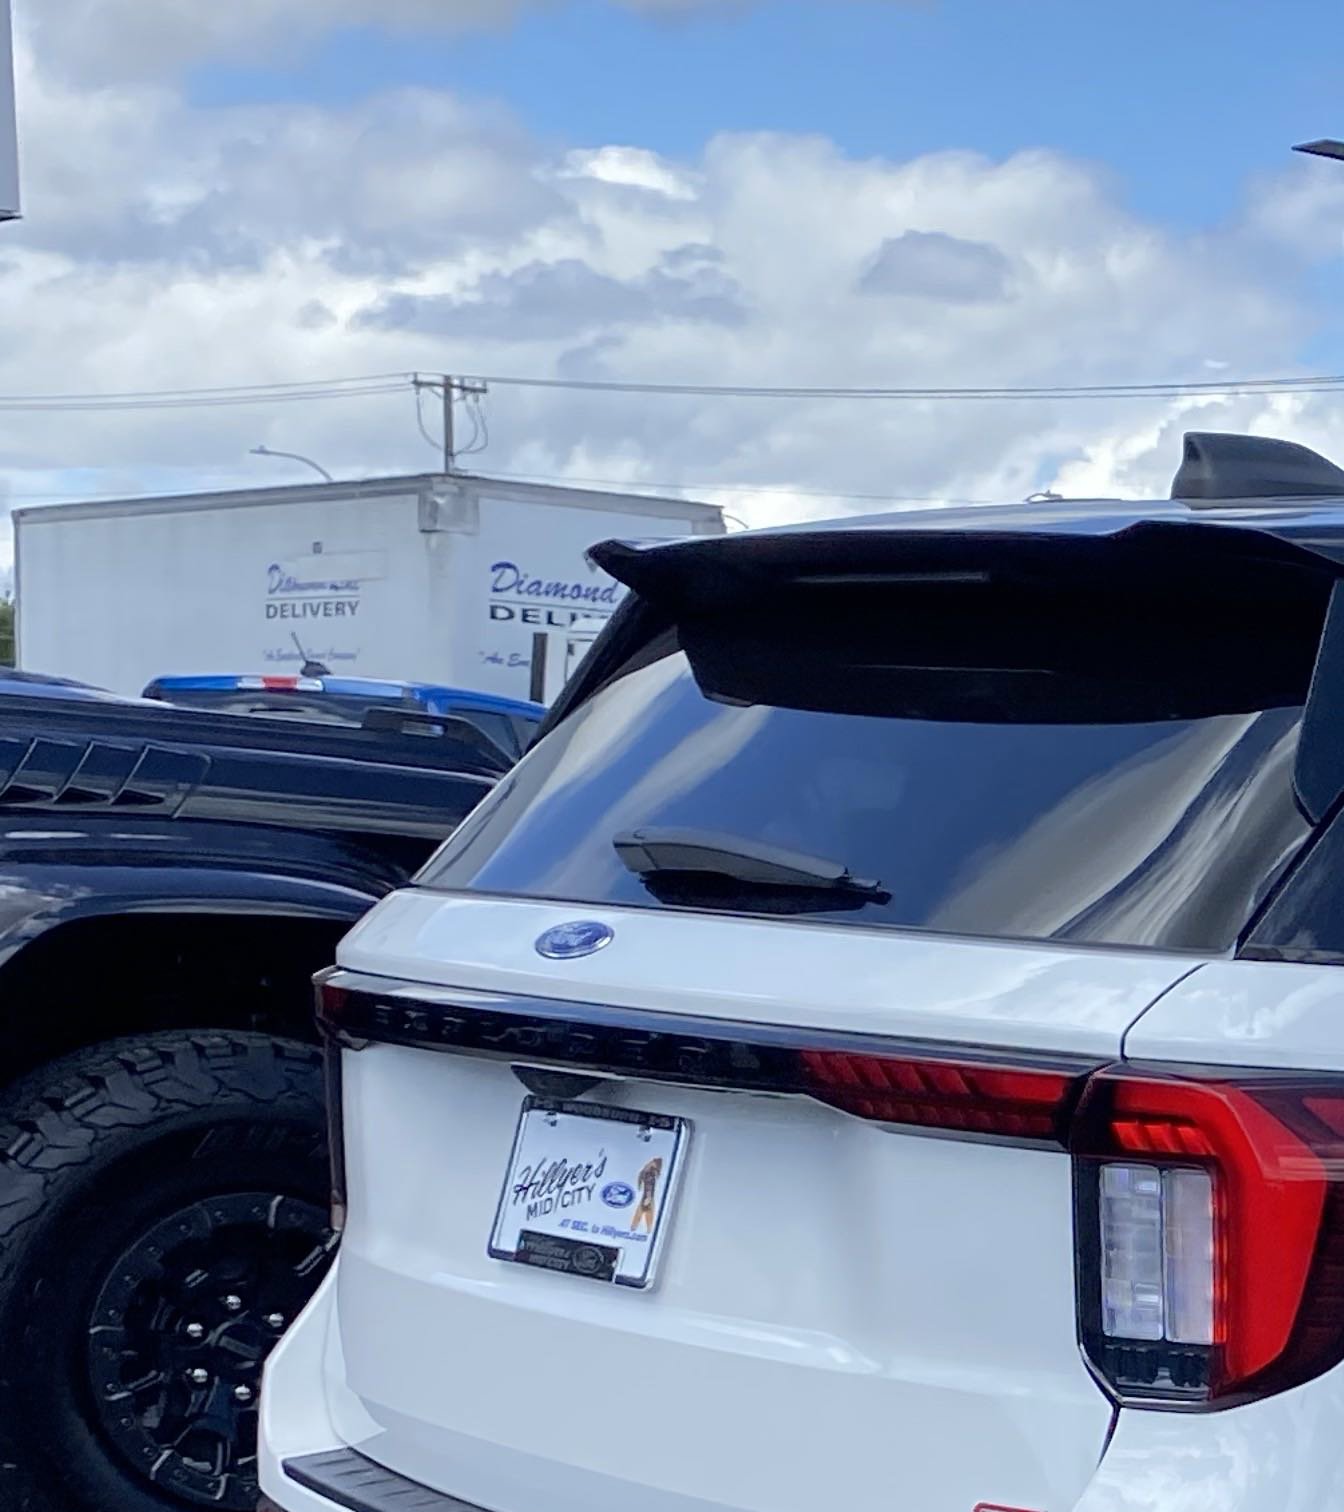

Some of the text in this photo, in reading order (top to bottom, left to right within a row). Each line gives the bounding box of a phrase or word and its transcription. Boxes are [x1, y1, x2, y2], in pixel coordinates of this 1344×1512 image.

[490, 561, 619, 604] Diamond
[264, 600, 361, 620] DELIVERY
[512, 1147, 608, 1212] Hillyer's
[526, 1196, 553, 1221] MID
[561, 1183, 597, 1208] CITY
